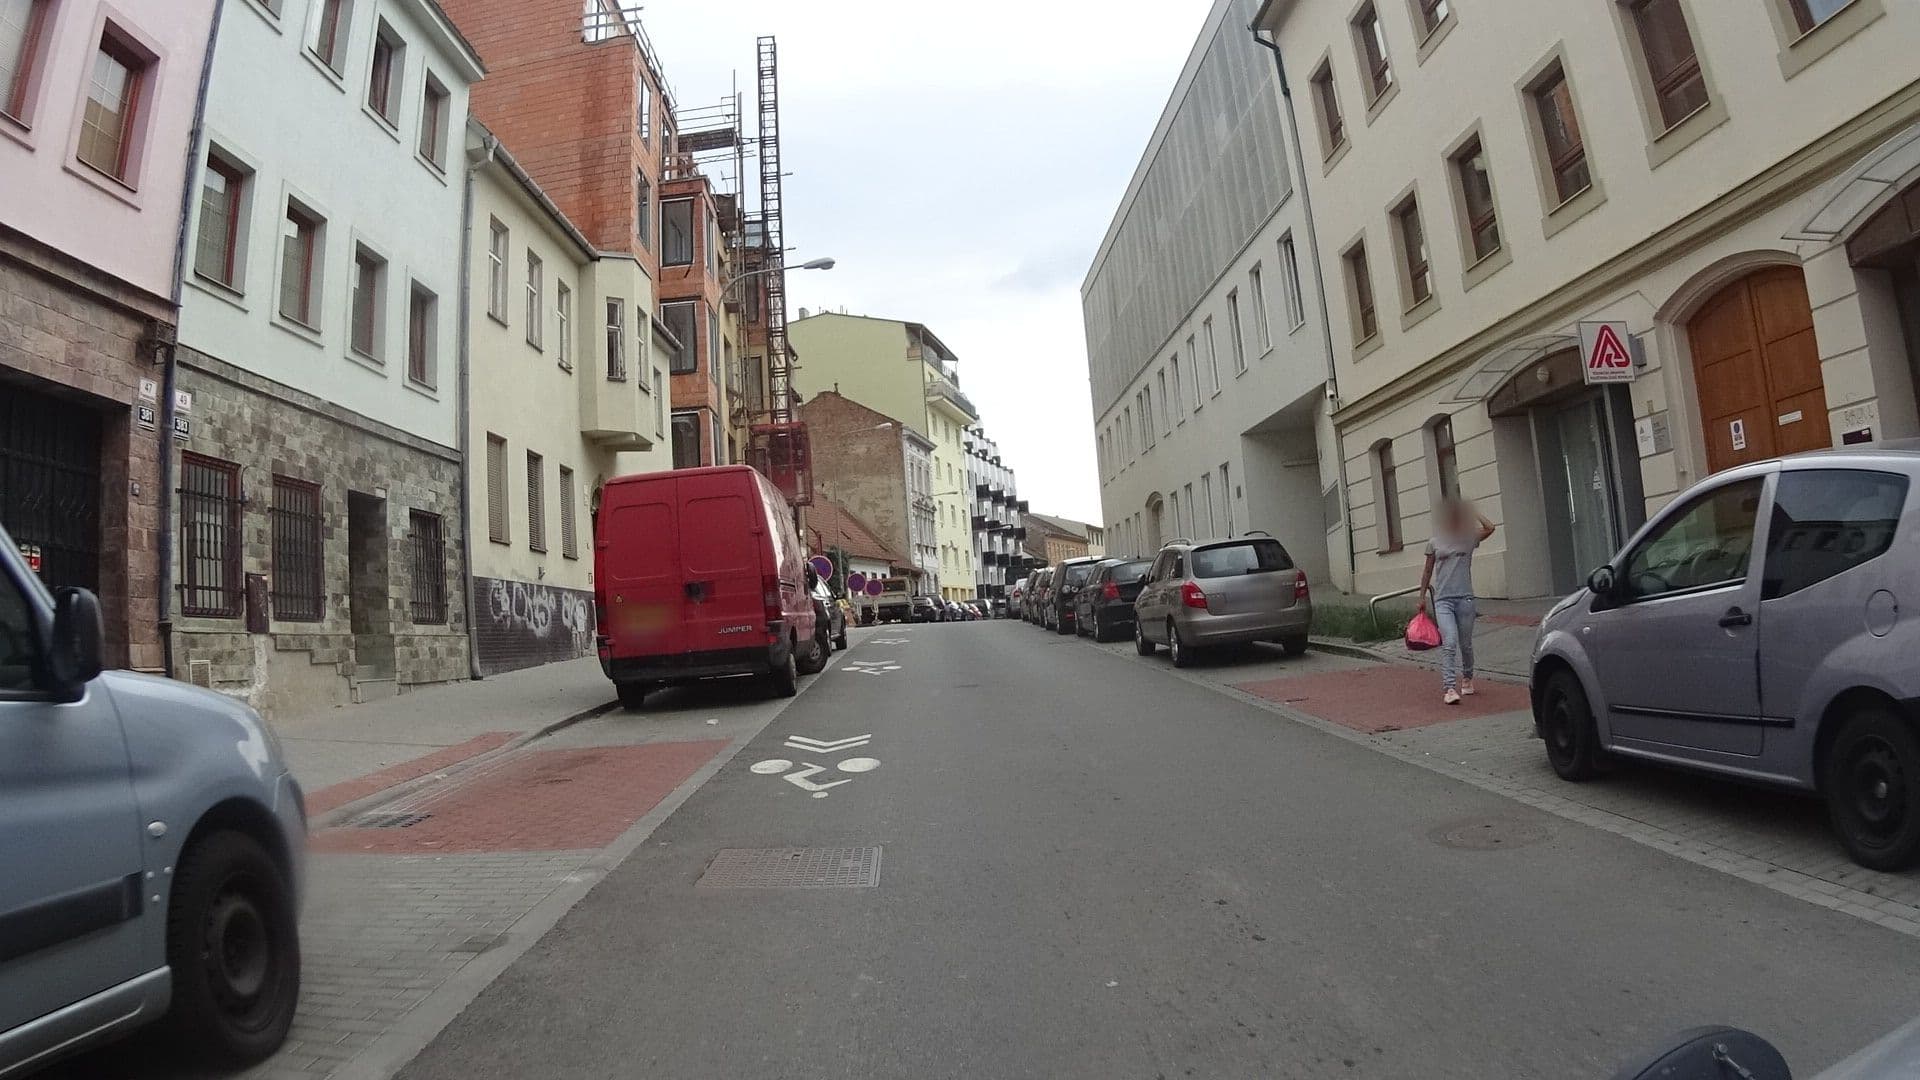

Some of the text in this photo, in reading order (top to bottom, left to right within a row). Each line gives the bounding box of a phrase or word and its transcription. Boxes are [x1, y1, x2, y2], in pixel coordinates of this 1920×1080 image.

[145, 383, 152, 393] 47
[141, 408, 153, 421] 381
[718, 626, 752, 634] JUMPER
